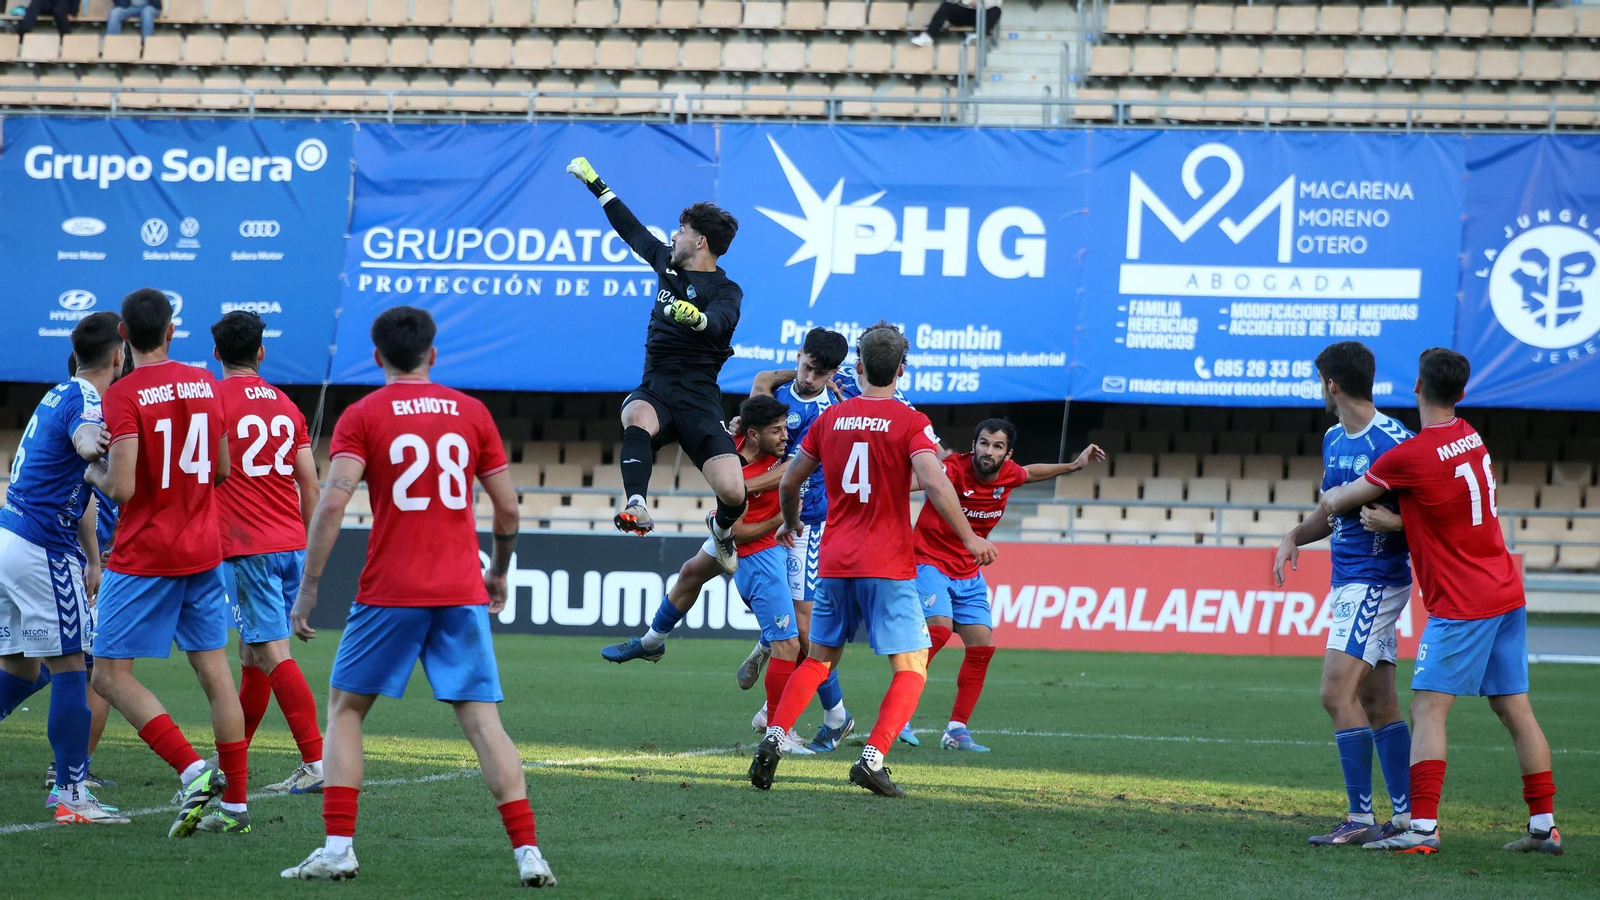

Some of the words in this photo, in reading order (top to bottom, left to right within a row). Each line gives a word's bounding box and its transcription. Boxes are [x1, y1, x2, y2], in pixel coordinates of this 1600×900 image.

[25, 145, 153, 189] Grupo
[161, 145, 293, 182] Solera
[1299, 179, 1414, 201] MACARENA
[1298, 207, 1391, 228] MORENO
[831, 204, 1048, 280] PHG
[1296, 234, 1369, 254] OTERO
[1475, 248, 1498, 278] LA
[358, 273, 542, 296] PROTECCIÓN
[556, 278, 590, 297] DE
[603, 279, 657, 298] DAT
[1186, 272, 1355, 293] ABOGADA
[1128, 301, 1183, 318] FAMILIA
[1230, 303, 1339, 321] MODIFICACIONES
[1340, 304, 1357, 321] DE
[1359, 304, 1419, 322] MEDIDAS
[1127, 317, 1199, 335] HERENCIAS
[1229, 320, 1307, 337] ACCIDENTES
[1308, 320, 1326, 337] DE
[1126, 333, 1196, 351] DIVORCIOS
[1532, 335, 1600, 364] JERE
[776, 348, 786, 364] y
[949, 355, 958, 367] e
[960, 352, 1005, 370] higiene
[1006, 352, 1067, 367] industrial
[1269, 360, 1289, 379] 33
[1291, 360, 1314, 378] 05
[138, 383, 175, 407] JORGE
[176, 378, 214, 400] GARCÍA
[914, 372, 944, 393] 145
[947, 372, 980, 393] 725
[244, 386, 278, 401] CARO
[391, 396, 460, 417] EKHIOTZ
[833, 416, 892, 432] MIRAPEIX
[10, 414, 38, 485] 6
[154, 412, 212, 489] 14
[237, 414, 295, 478] 22
[389, 432, 470, 512] 28
[841, 441, 871, 504] 4
[966, 509, 1003, 519] AirEuropa
[498, 551, 761, 630] humme
[231, 604, 243, 623] 22
